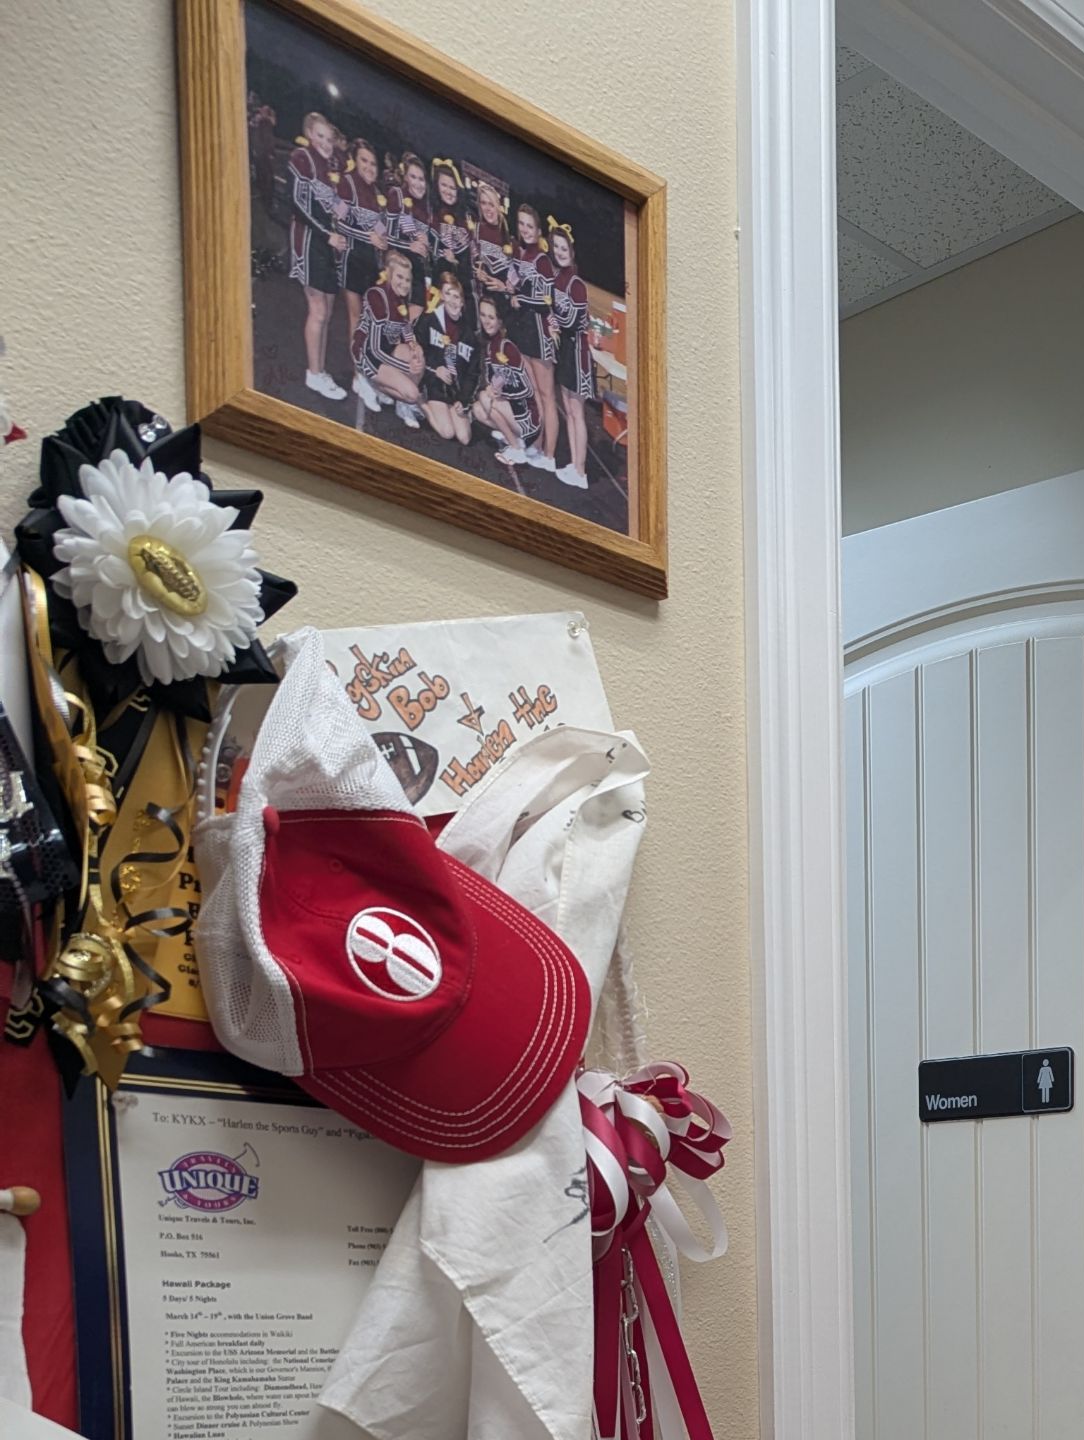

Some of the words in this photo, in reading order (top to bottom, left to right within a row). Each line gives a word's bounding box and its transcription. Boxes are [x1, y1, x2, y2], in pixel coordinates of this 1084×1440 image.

[387, 671, 451, 731] Bob
[509, 685, 558, 729] the
[926, 1094, 978, 1111] Women
[152, 1112, 169, 1123] To:
[172, 1112, 207, 1126] KYKX
[255, 1119, 270, 1131] the
[271, 1121, 300, 1135] Sports
[326, 1127, 342, 1137] and
[158, 1169, 260, 1200] UNIQUE
[186, 1251, 197, 1260] TX
[161, 1279, 193, 1289] Hawaii
[194, 1280, 232, 1291] Package
[165, 1312, 188, 1321] March
